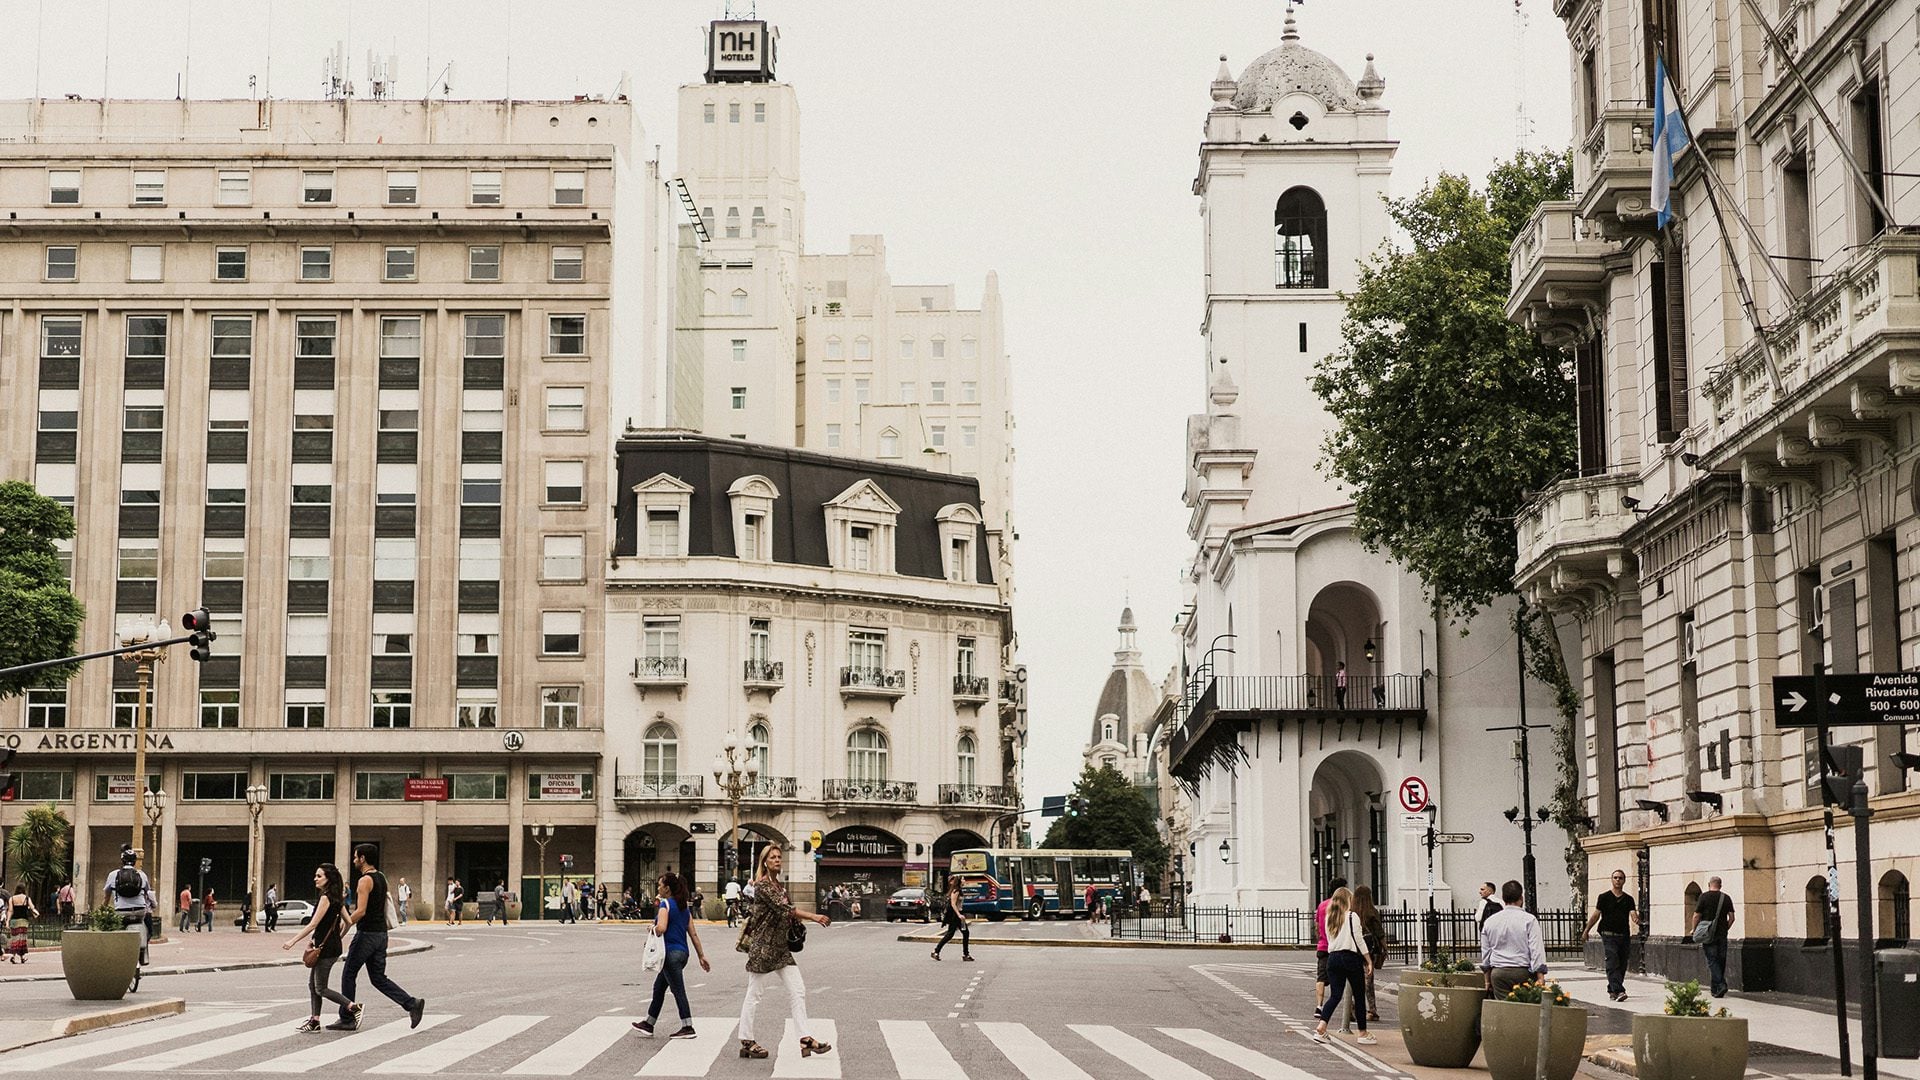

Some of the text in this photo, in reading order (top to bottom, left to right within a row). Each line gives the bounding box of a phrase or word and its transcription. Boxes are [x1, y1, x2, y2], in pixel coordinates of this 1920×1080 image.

[721, 53, 754, 61] HOTELES
[1873, 674, 1917, 685] Avenida
[1865, 686, 1919, 697] Rivadavia
[1870, 701, 1890, 711] 500
[1899, 700, 1920, 710] 600
[37, 733, 174, 749] ARGENTINA
[1407, 784, 1421, 804] E
[836, 841, 854, 854] GRAN
